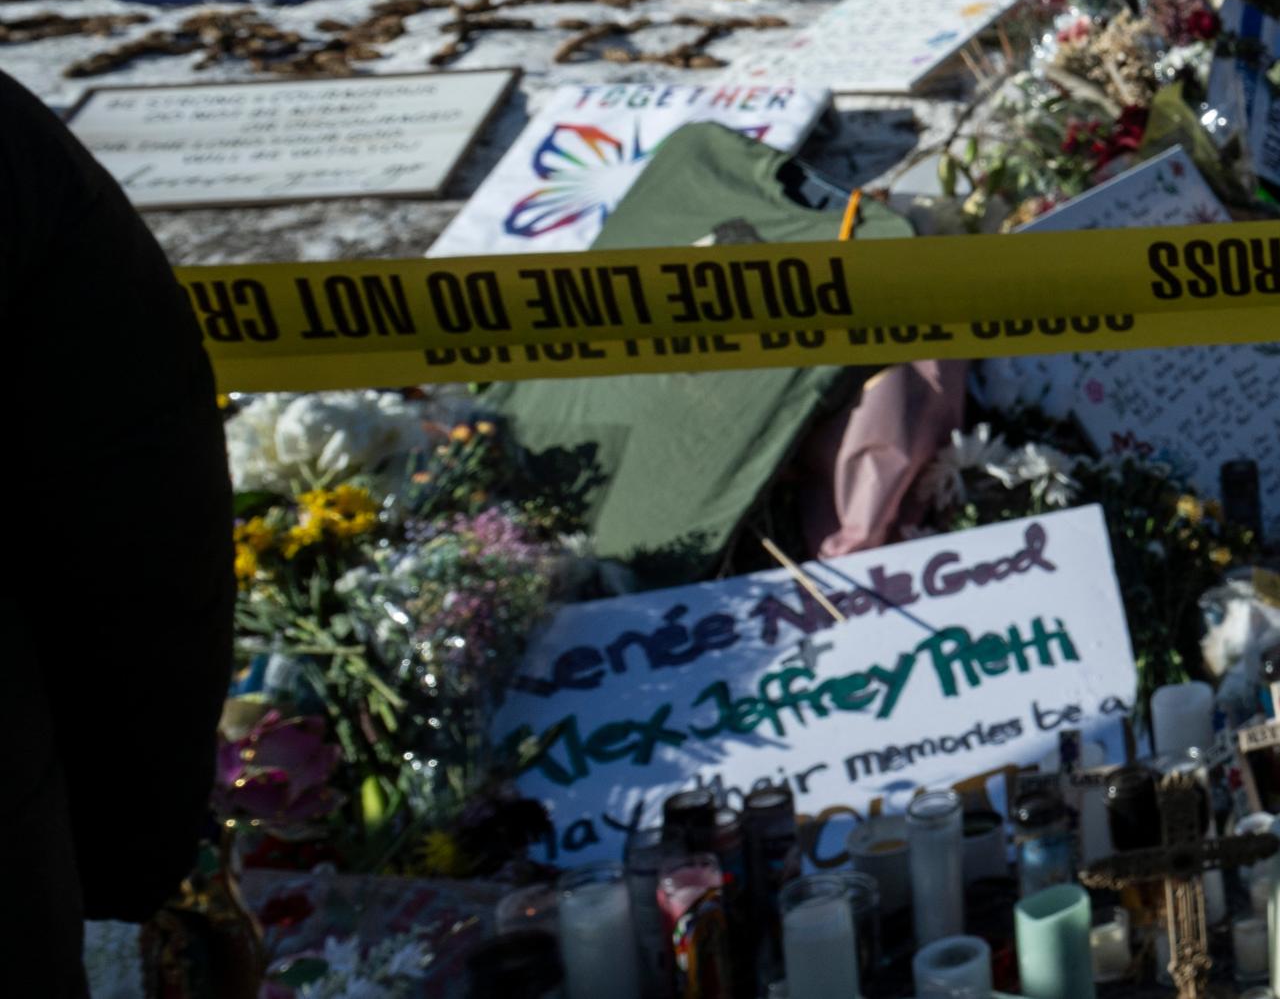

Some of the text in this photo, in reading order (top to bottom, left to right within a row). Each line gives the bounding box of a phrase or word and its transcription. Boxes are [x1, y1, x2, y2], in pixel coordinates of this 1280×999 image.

[576, 84, 795, 110] TOGETHER
[295, 274, 416, 338] NOT
[427, 270, 505, 334] DO
[519, 265, 652, 328] LINE
[662, 257, 853, 323] POLICE
[921, 521, 1058, 598] Good
[687, 652, 916, 740] Jeffrey
[914, 615, 1082, 698] Pretti
[843, 716, 1023, 793] memories
[1031, 700, 1082, 732] be
[1099, 695, 1133, 715] a
